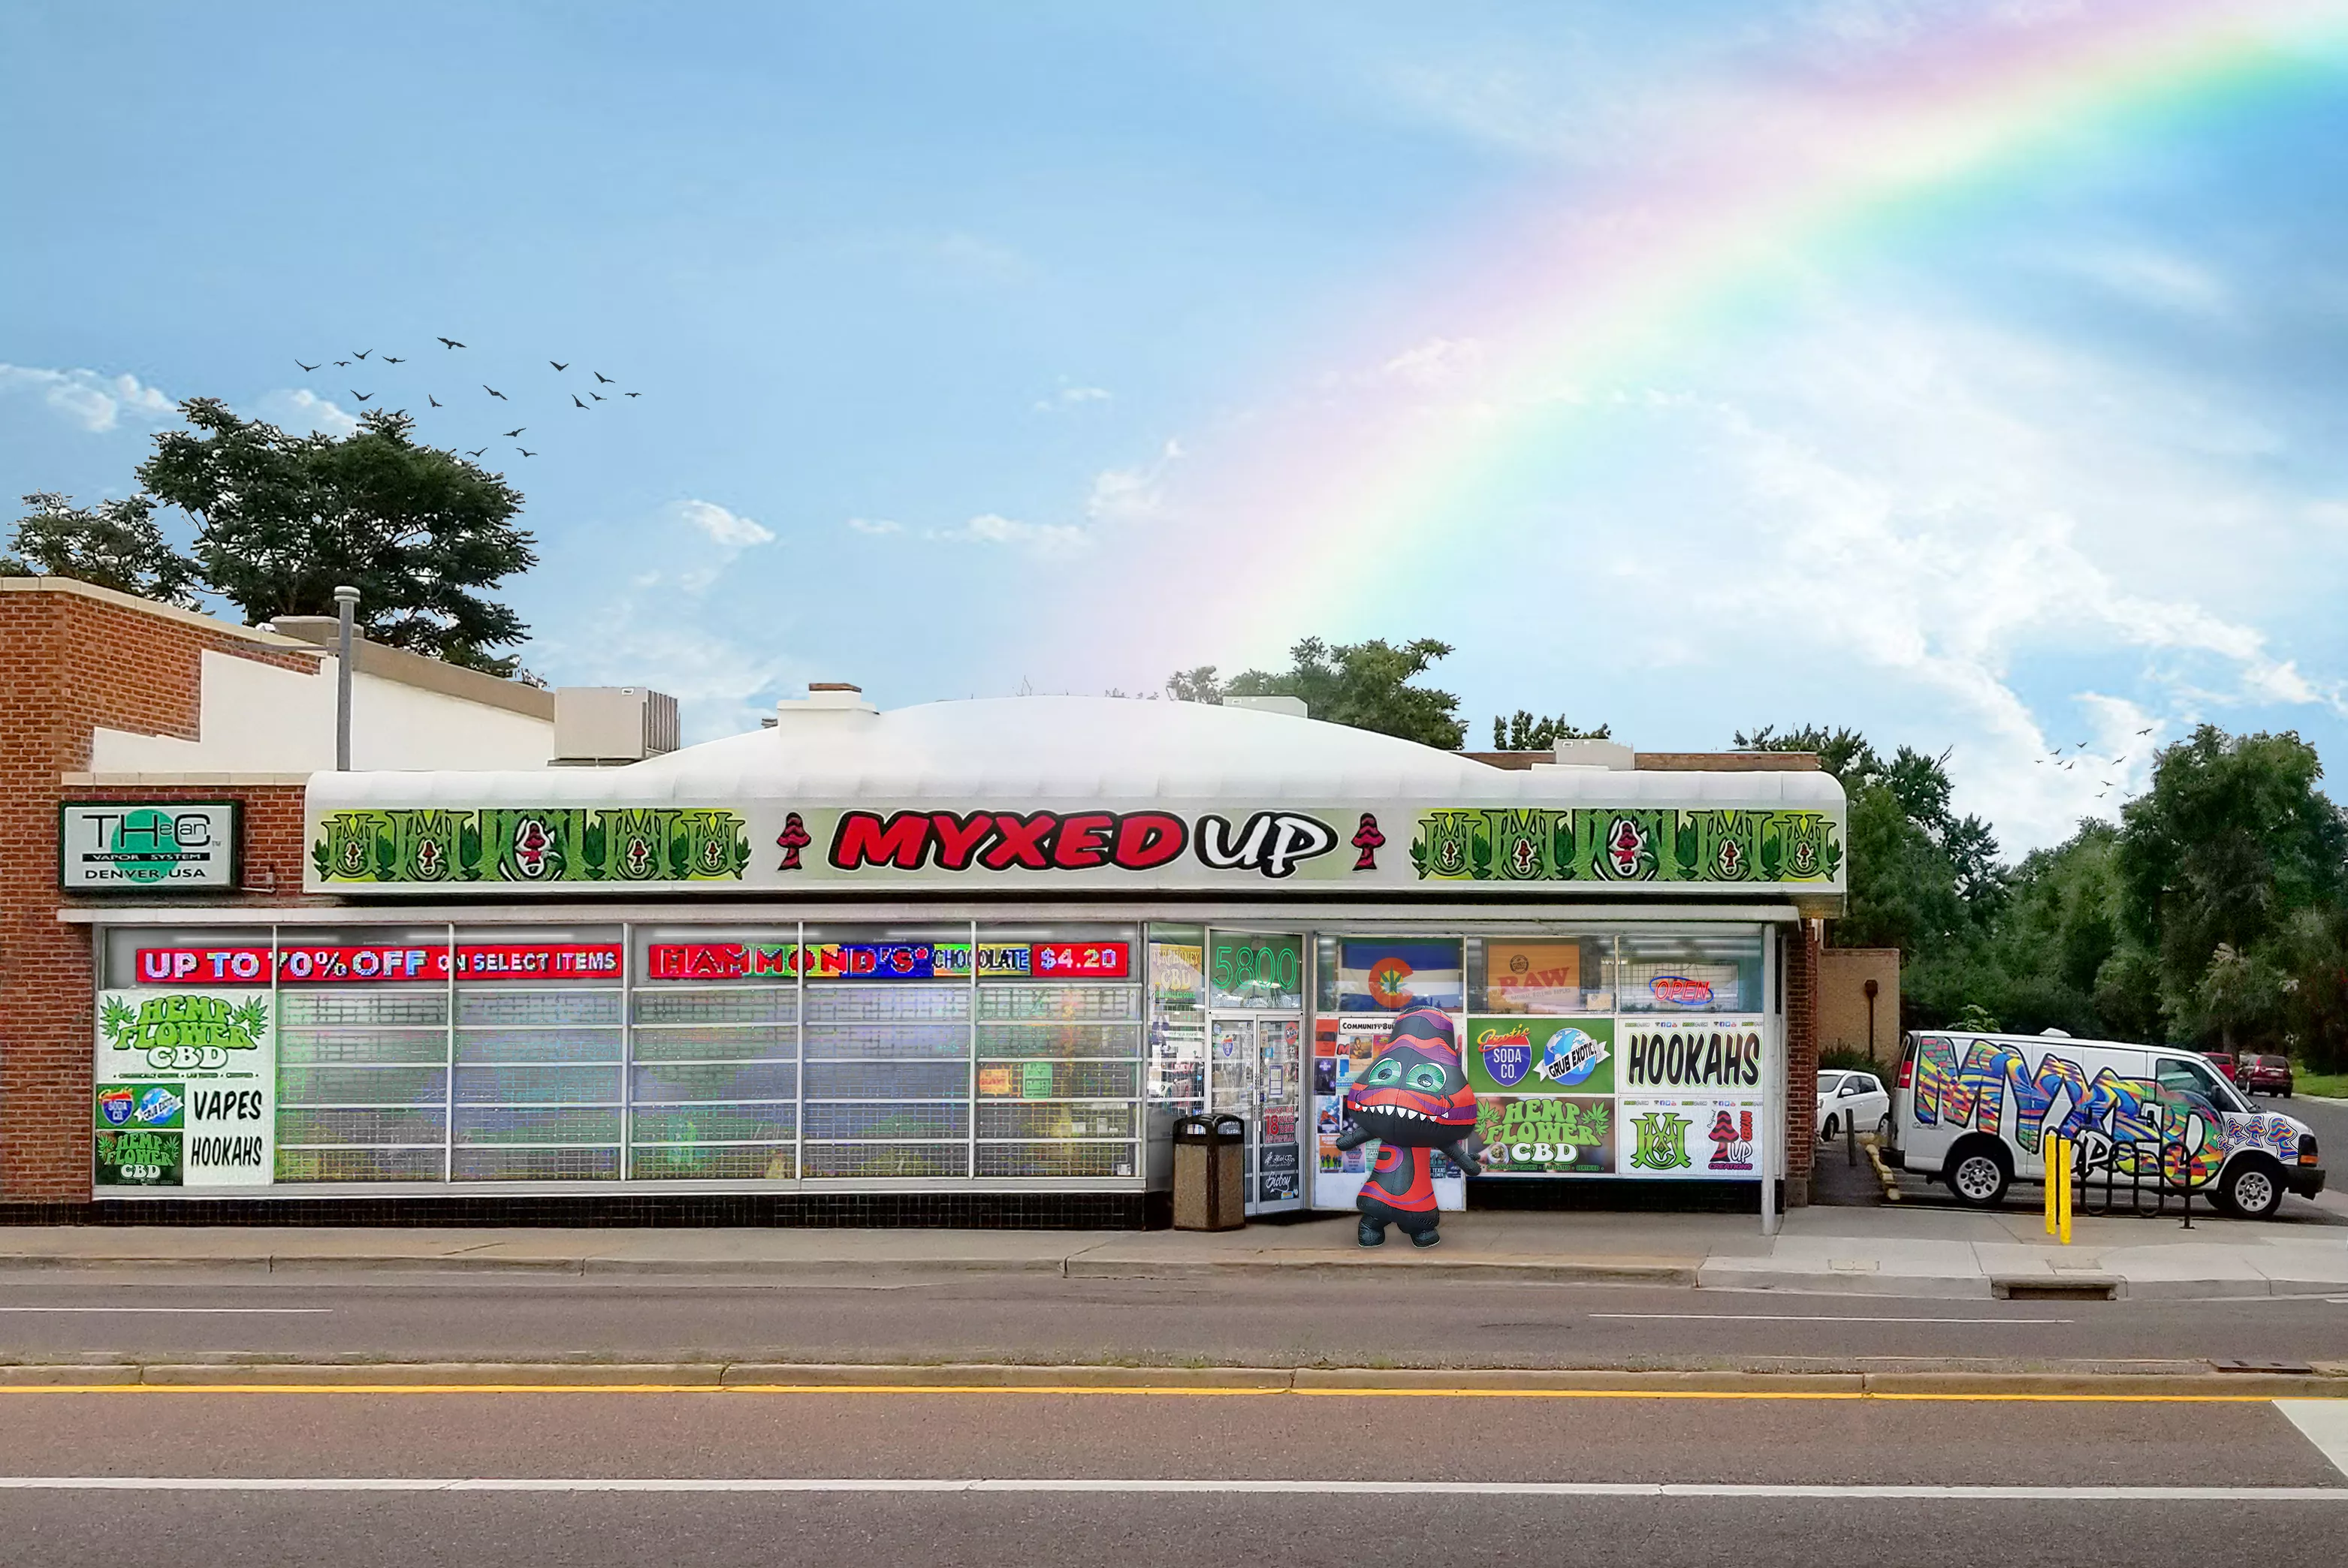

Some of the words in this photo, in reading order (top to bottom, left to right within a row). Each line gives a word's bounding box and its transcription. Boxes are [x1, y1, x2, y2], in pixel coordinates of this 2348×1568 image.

[829, 811, 1188, 871] MYXED
[1195, 812, 1338, 879] UP
[167, 868, 207, 879] USA
[146, 952, 198, 978] UP
[207, 952, 260, 978] TO
[352, 950, 429, 976] OFF
[473, 952, 549, 972] SELECT
[556, 951, 617, 970] ITEMS
[1040, 948, 1117, 969] $4.20
[1213, 946, 1296, 990] 5800
[1160, 969, 1191, 991] CBD
[1498, 966, 1569, 995] RAW
[1655, 980, 1710, 1001] OPEN
[137, 994, 232, 1024] HEMP
[113, 1022, 257, 1050] FLOWER
[1477, 1024, 1530, 1053] Exotic
[146, 1045, 229, 1069] CBD
[1494, 1048, 1522, 1063] SODA
[1549, 1056, 1571, 1078] GRUB
[1629, 1033, 1761, 1087] HOOKAHS
[1501, 1064, 1517, 1078] CO.
[195, 1090, 262, 1120] VAPES
[1506, 1099, 1581, 1123] HEMP
[1265, 1114, 1279, 1135] 18
[1707, 1109, 1717, 1129] Original
[1740, 1111, 1752, 1141] MYXED
[116, 1132, 163, 1150] HEMP
[1483, 1121, 1602, 1146] FLOWER
[104, 1149, 175, 1166] FLOWER
[190, 1136, 263, 1165] HOOKAHS
[1510, 1141, 1578, 1163] CBD
[1730, 1141, 1753, 1164] UP
[120, 1164, 161, 1178] CBD
